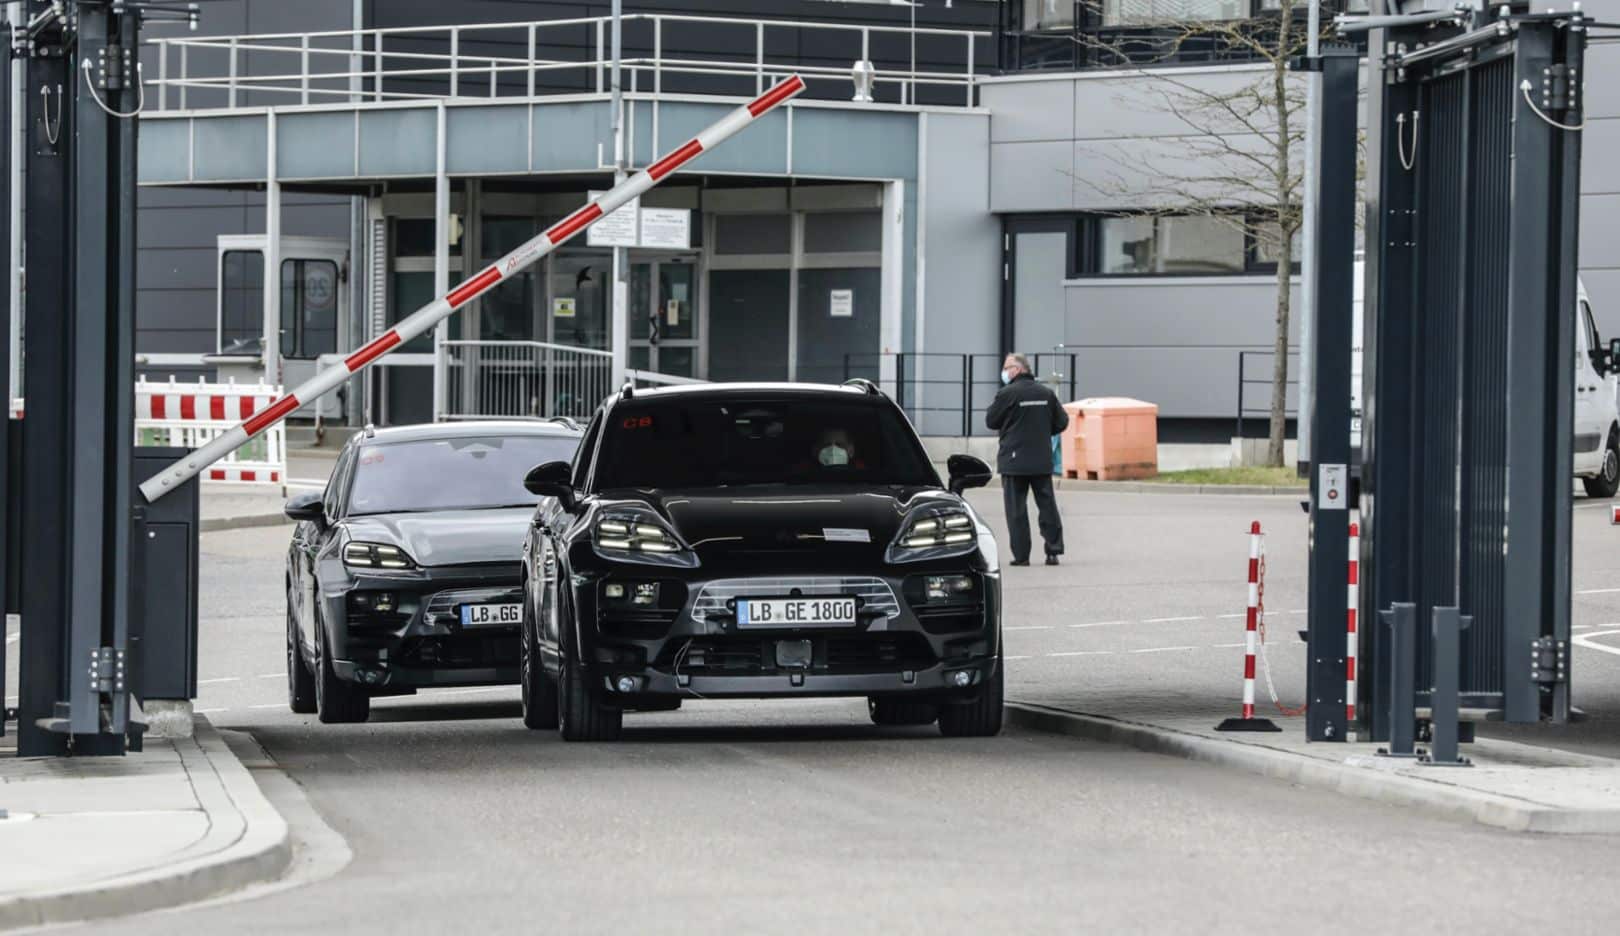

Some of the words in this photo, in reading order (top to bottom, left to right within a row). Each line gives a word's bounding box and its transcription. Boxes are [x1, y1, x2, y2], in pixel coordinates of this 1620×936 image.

[471, 606, 489, 623] LB
[500, 605, 518, 621] GG
[750, 602, 772, 622] LB
[785, 602, 807, 621] GE
[811, 601, 854, 621] 1800
